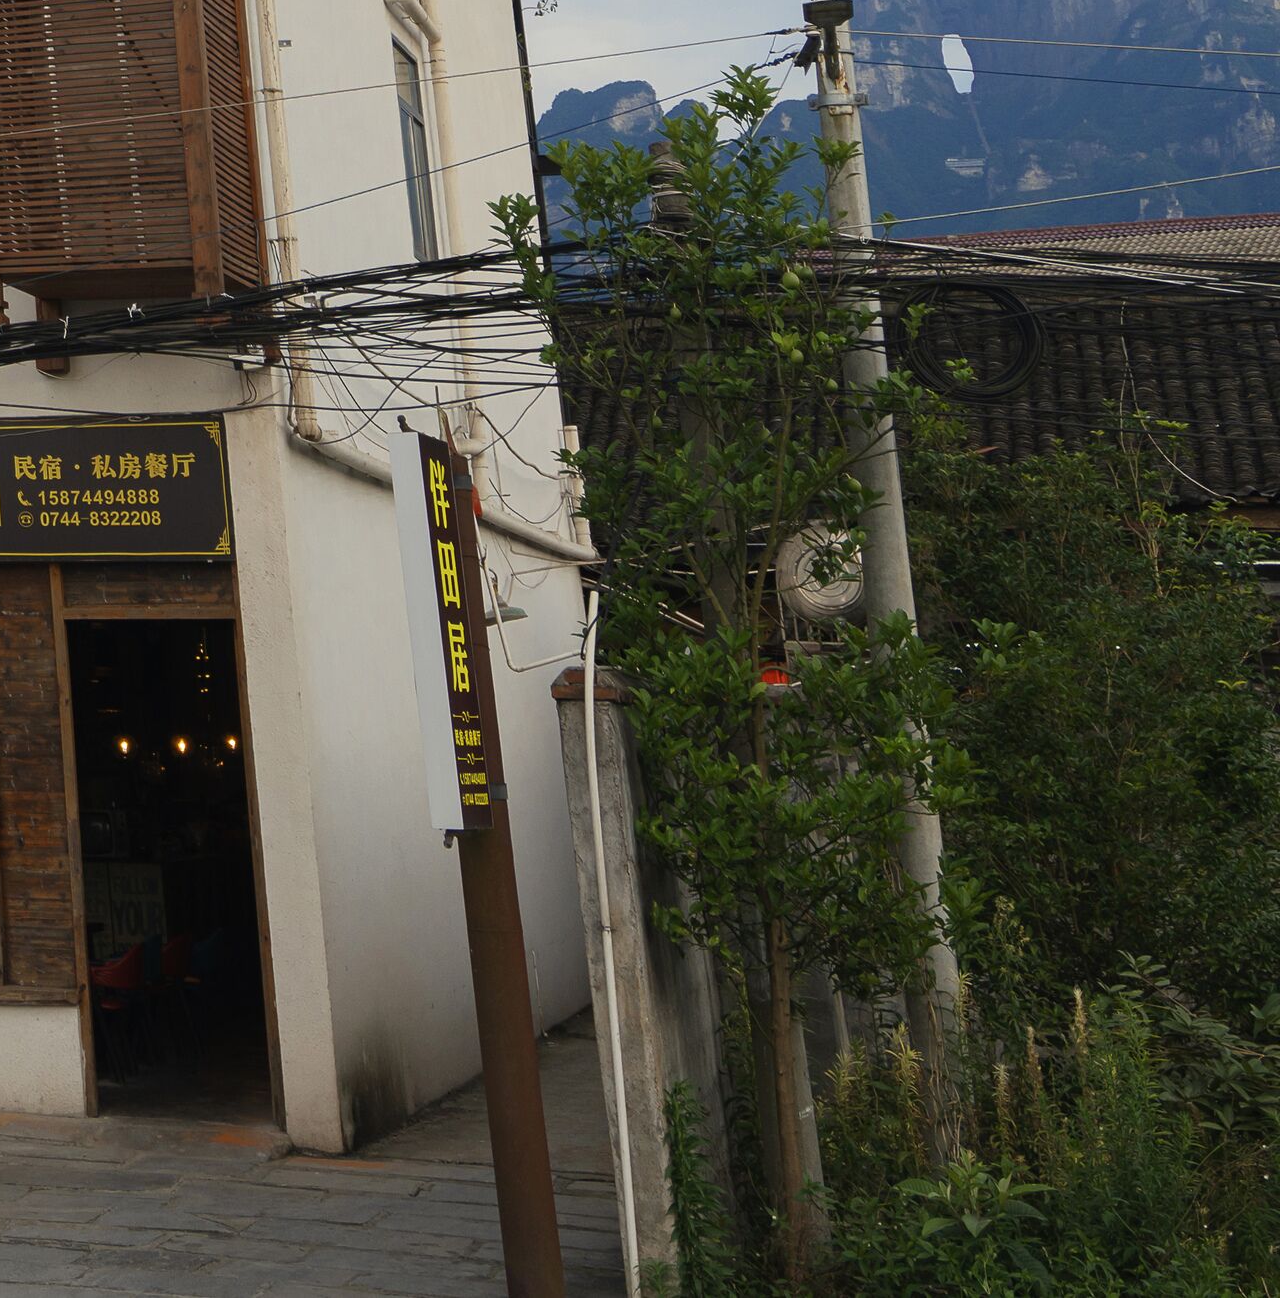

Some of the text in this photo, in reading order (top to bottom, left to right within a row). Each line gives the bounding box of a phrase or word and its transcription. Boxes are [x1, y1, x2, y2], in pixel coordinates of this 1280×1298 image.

[38, 489, 160, 506] 15874494888
[40, 511, 162, 527] 0744-8322208
[429, 458, 470, 693] 伴田居
